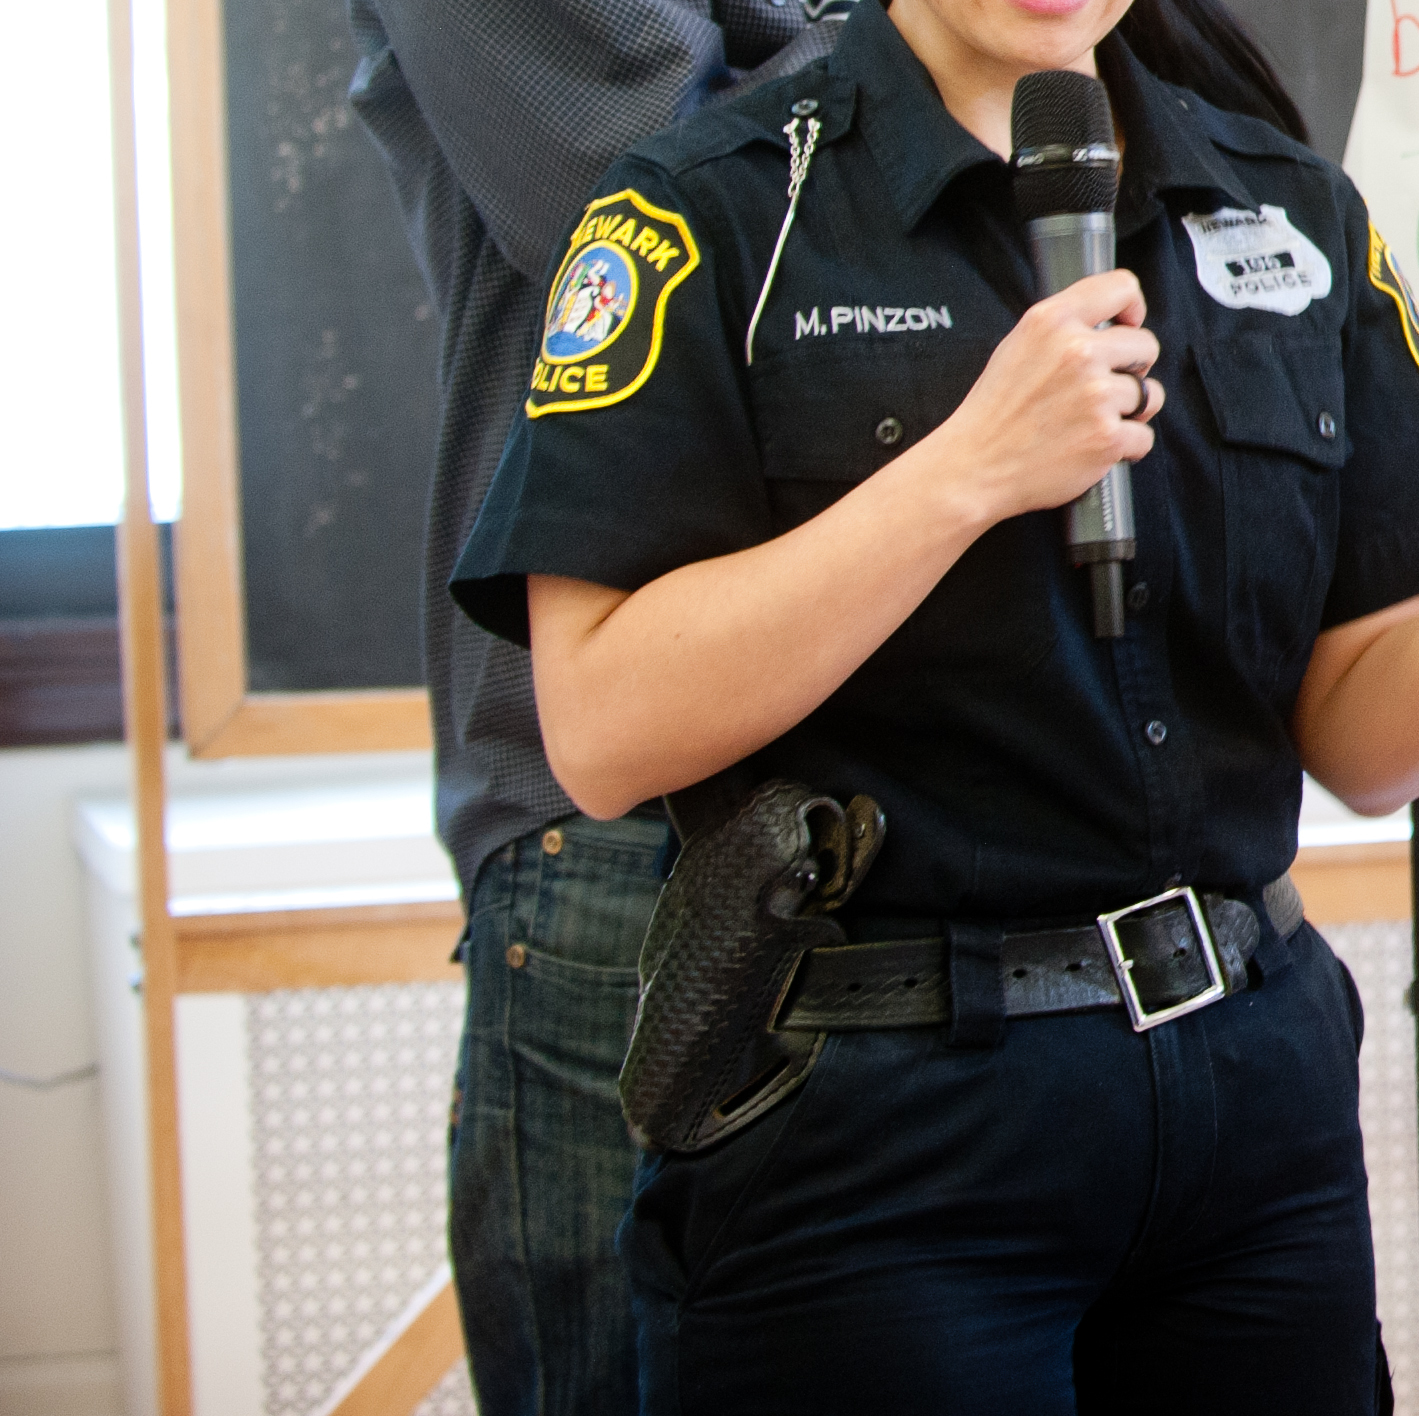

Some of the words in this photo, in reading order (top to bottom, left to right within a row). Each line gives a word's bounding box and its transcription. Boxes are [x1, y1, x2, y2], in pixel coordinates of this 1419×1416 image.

[574, 213, 681, 273] EWARK
[1229, 271, 1313, 298] POLICE
[530, 362, 610, 394] OLICE
